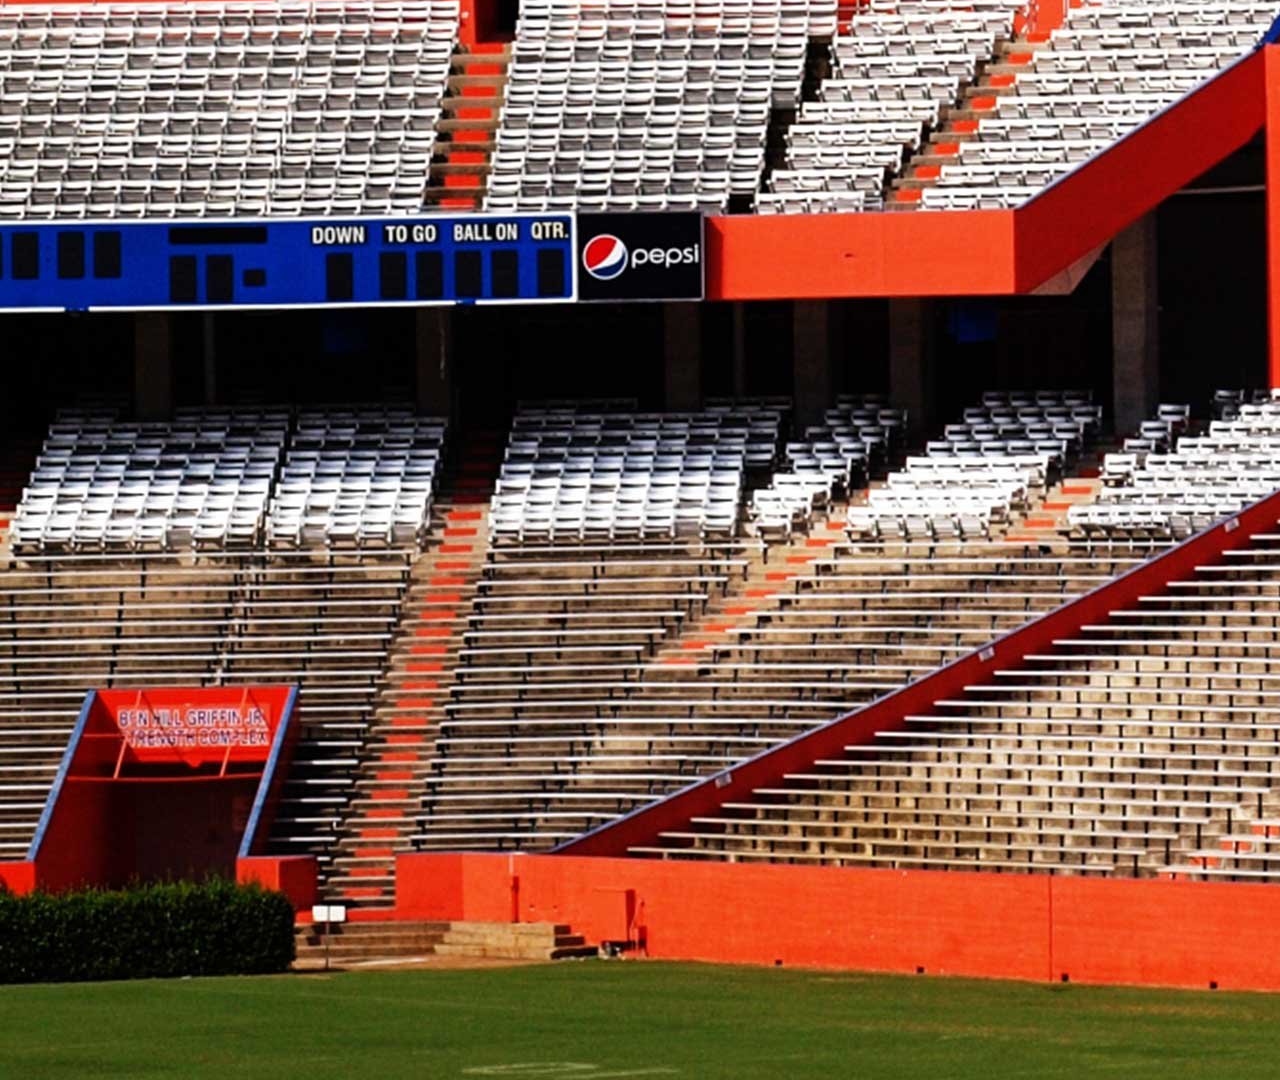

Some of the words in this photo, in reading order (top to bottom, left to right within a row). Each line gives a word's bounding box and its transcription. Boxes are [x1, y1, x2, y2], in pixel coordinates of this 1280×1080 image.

[312, 227, 366, 244] DOWN
[385, 225, 408, 243] TO
[412, 224, 437, 243] GO
[453, 224, 493, 241] BALL
[495, 223, 518, 241] ON
[530, 222, 569, 240] QTR.
[631, 243, 699, 269] pepsi
[187, 708, 242, 727] GRIFFIN
[126, 728, 198, 747] TRENGTH
[199, 728, 270, 746] COMPLEX
